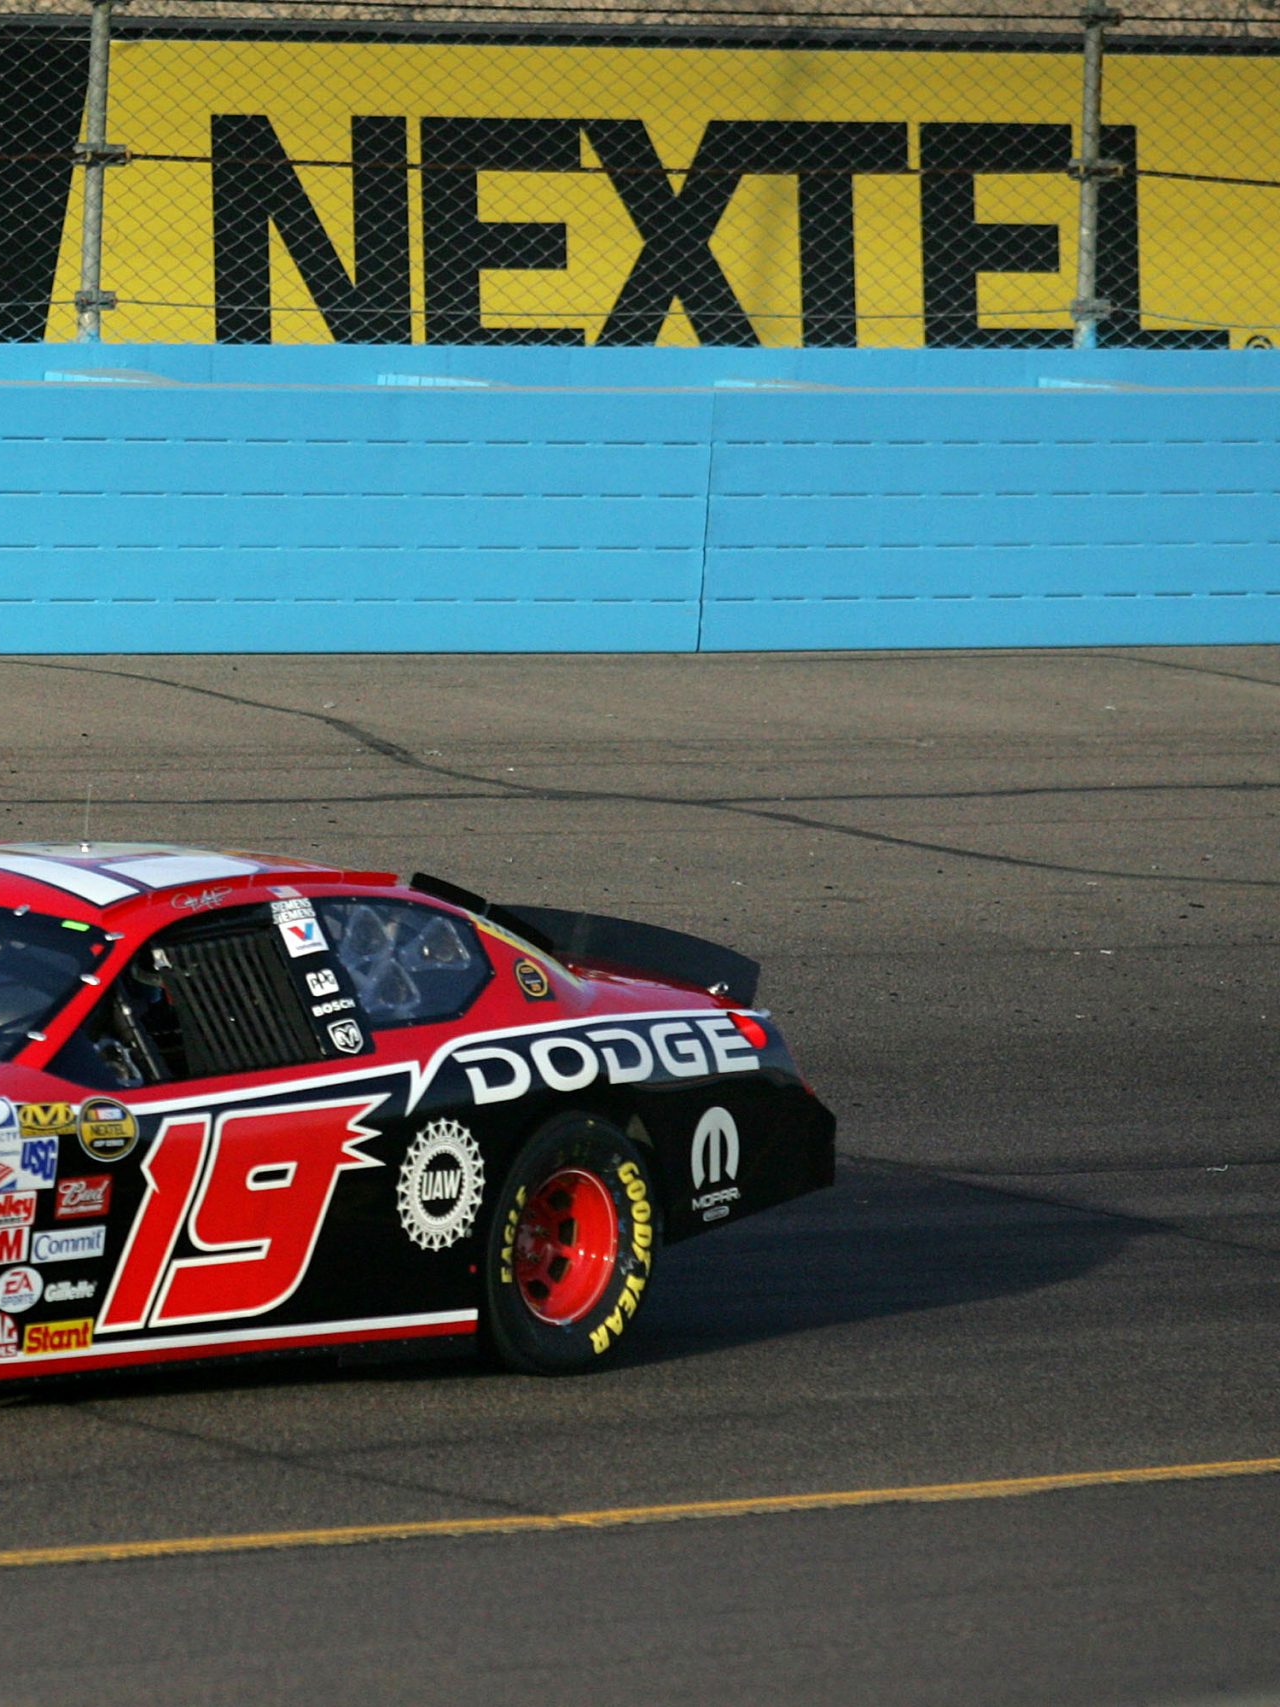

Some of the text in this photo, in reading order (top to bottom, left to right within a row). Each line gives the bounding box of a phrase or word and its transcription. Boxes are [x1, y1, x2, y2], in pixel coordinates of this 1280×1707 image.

[210, 114, 1230, 348] NEXTEL
[311, 999, 356, 1017] BOSCH
[451, 1018, 761, 1105] DODGE
[93, 1092, 392, 1335] 19
[421, 1169, 460, 1200] UAW
[34, 1230, 102, 1261] Commit
[589, 1161, 653, 1355] GOODYEAR
[26, 1321, 90, 1355] Stant
